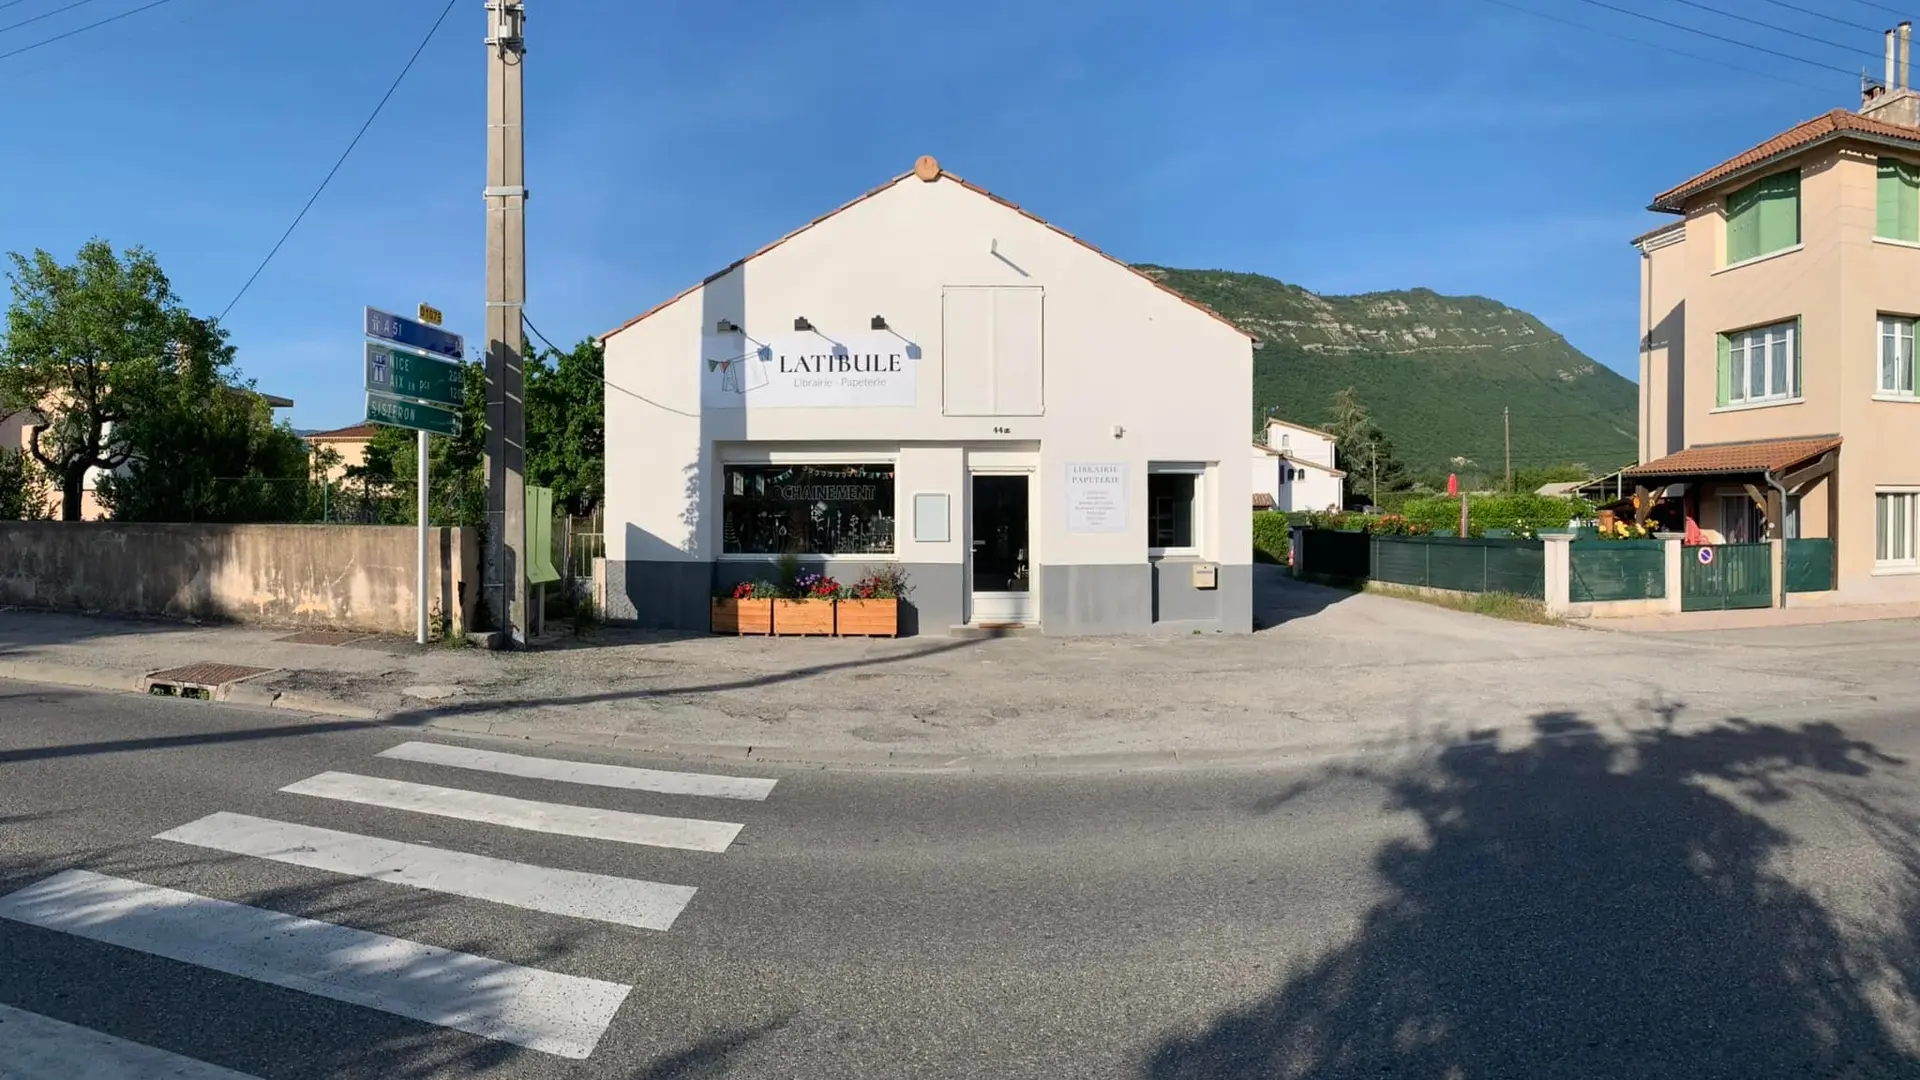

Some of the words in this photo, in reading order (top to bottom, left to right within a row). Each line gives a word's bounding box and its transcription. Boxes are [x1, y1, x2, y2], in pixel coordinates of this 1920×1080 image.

[392, 321, 402, 337] 51
[389, 353, 410, 372] NICE
[780, 354, 901, 373] LATIBULE
[389, 374, 404, 389] AIX
[794, 378, 832, 387] Librairie
[841, 378, 886, 388] Papeterie
[371, 400, 416, 421] SISTERON
